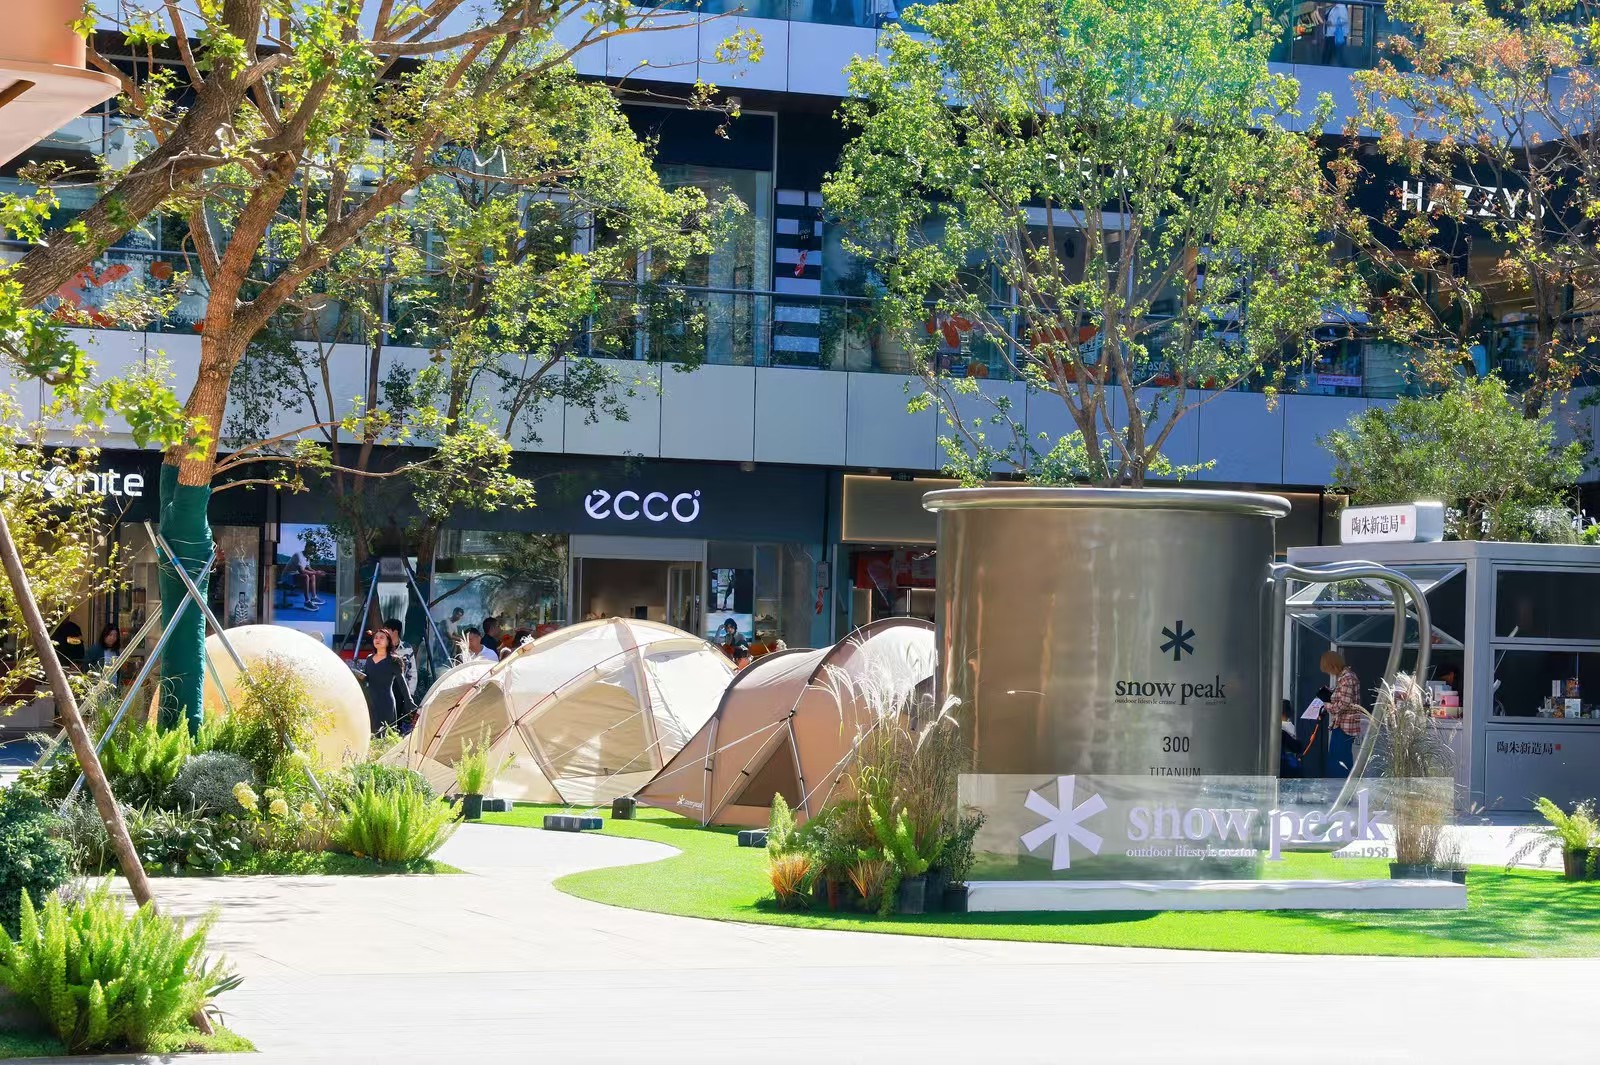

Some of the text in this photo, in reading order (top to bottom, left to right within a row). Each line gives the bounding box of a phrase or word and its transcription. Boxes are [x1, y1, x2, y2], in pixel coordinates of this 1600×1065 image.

[1351, 514, 1399, 535] 陶朱新造局
[1115, 675, 1226, 705] snow peak
[1162, 736, 1190, 753] 300
[1496, 740, 1553, 755] 陶朱新造局
[1149, 767, 1201, 777] TITANIUM
[1127, 788, 1389, 861] snow peak
[1126, 845, 1172, 857] outdoor
[1175, 844, 1217, 860] lifestyle
